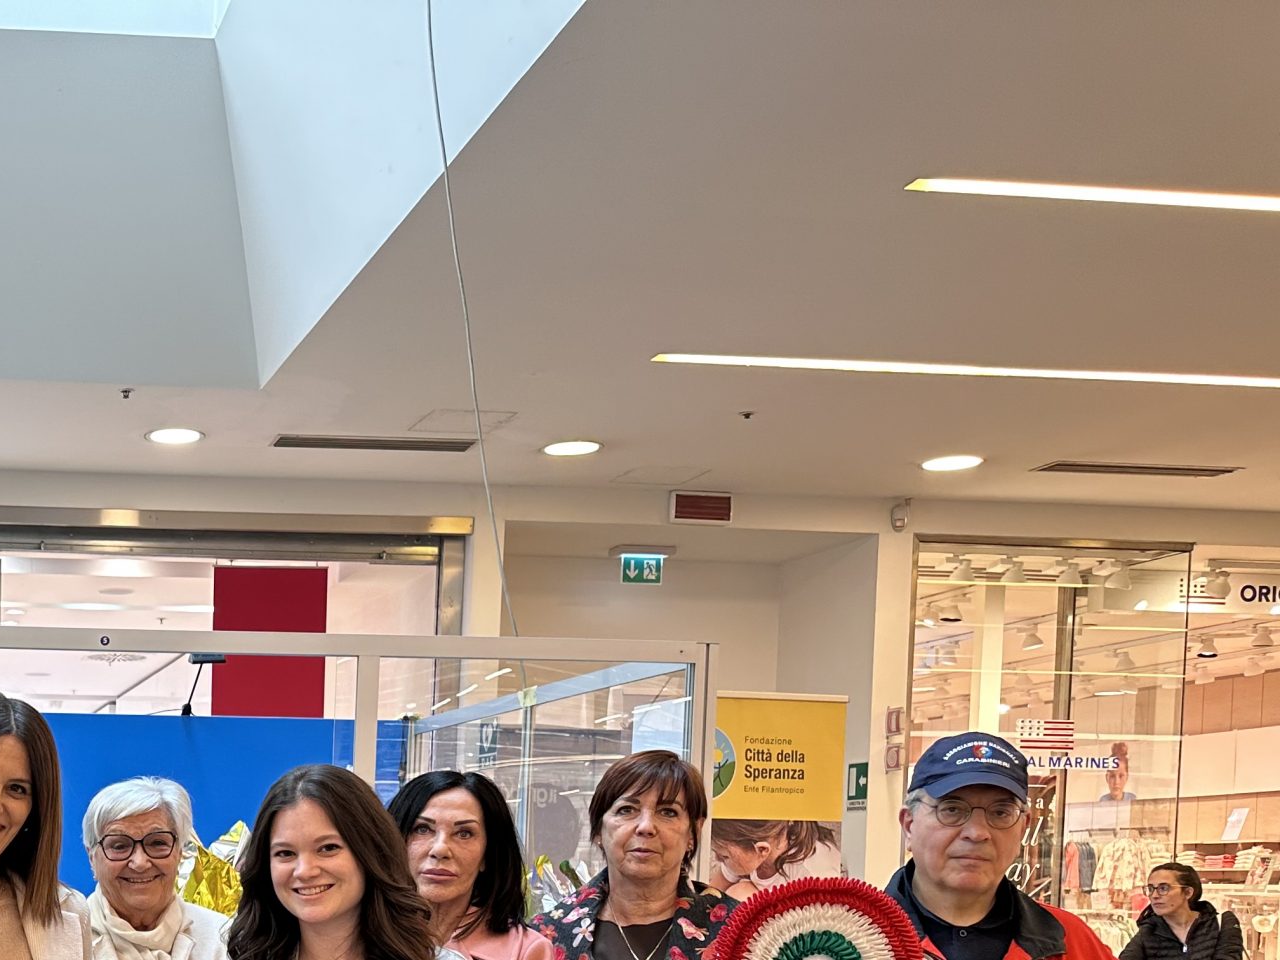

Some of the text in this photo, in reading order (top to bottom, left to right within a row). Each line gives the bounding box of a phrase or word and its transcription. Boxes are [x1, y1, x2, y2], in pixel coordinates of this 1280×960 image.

[744, 735, 793, 746] Fondazione
[744, 748, 805, 763] Città della
[956, 757, 1010, 769] CARABINIERI
[744, 764, 805, 782] Speranza
[743, 785, 805, 795] Ente Filantropico
